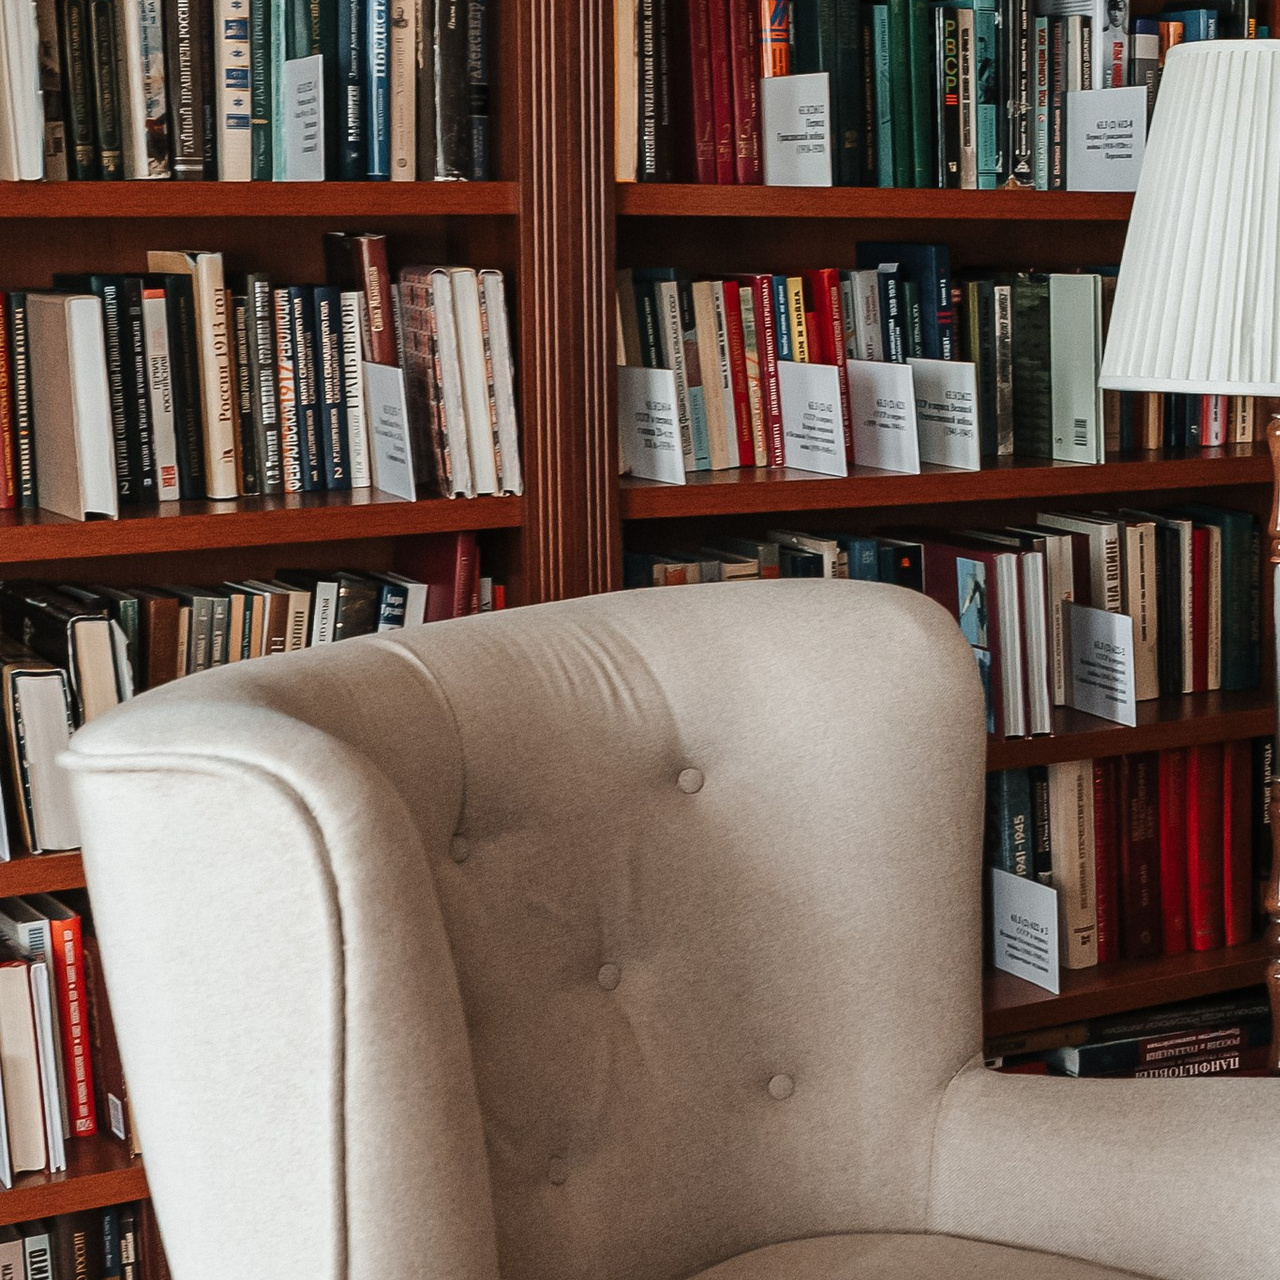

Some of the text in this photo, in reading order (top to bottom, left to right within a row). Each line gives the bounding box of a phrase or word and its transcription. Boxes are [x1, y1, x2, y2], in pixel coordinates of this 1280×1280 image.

[179, 40, 192, 103] ПРАВИТЕЛЬ
[254, 49, 265, 104] ДАЛЕКОМ
[181, 106, 194, 154] ТАЙНЫЙ
[369, 266, 380, 307] Мамонтов
[212, 288, 231, 422] Россия 1913 год
[342, 302, 357, 355] ВЕКОВ
[275, 290, 301, 491] ФЕВРАЛЬСКАЯ 1917 РЕВОЛЮЦИЯ
[768, 377, 779, 416] ДНЕВНИК
[1104, 539, 1119, 602] НА ВОЙНЕ
[1014, 815, 1027, 876] 1941-1945
[1135, 1057, 1239, 1078] ПАНФИЛОВЦЫ
[74, 1232, 87, 1272] РОССИИ
